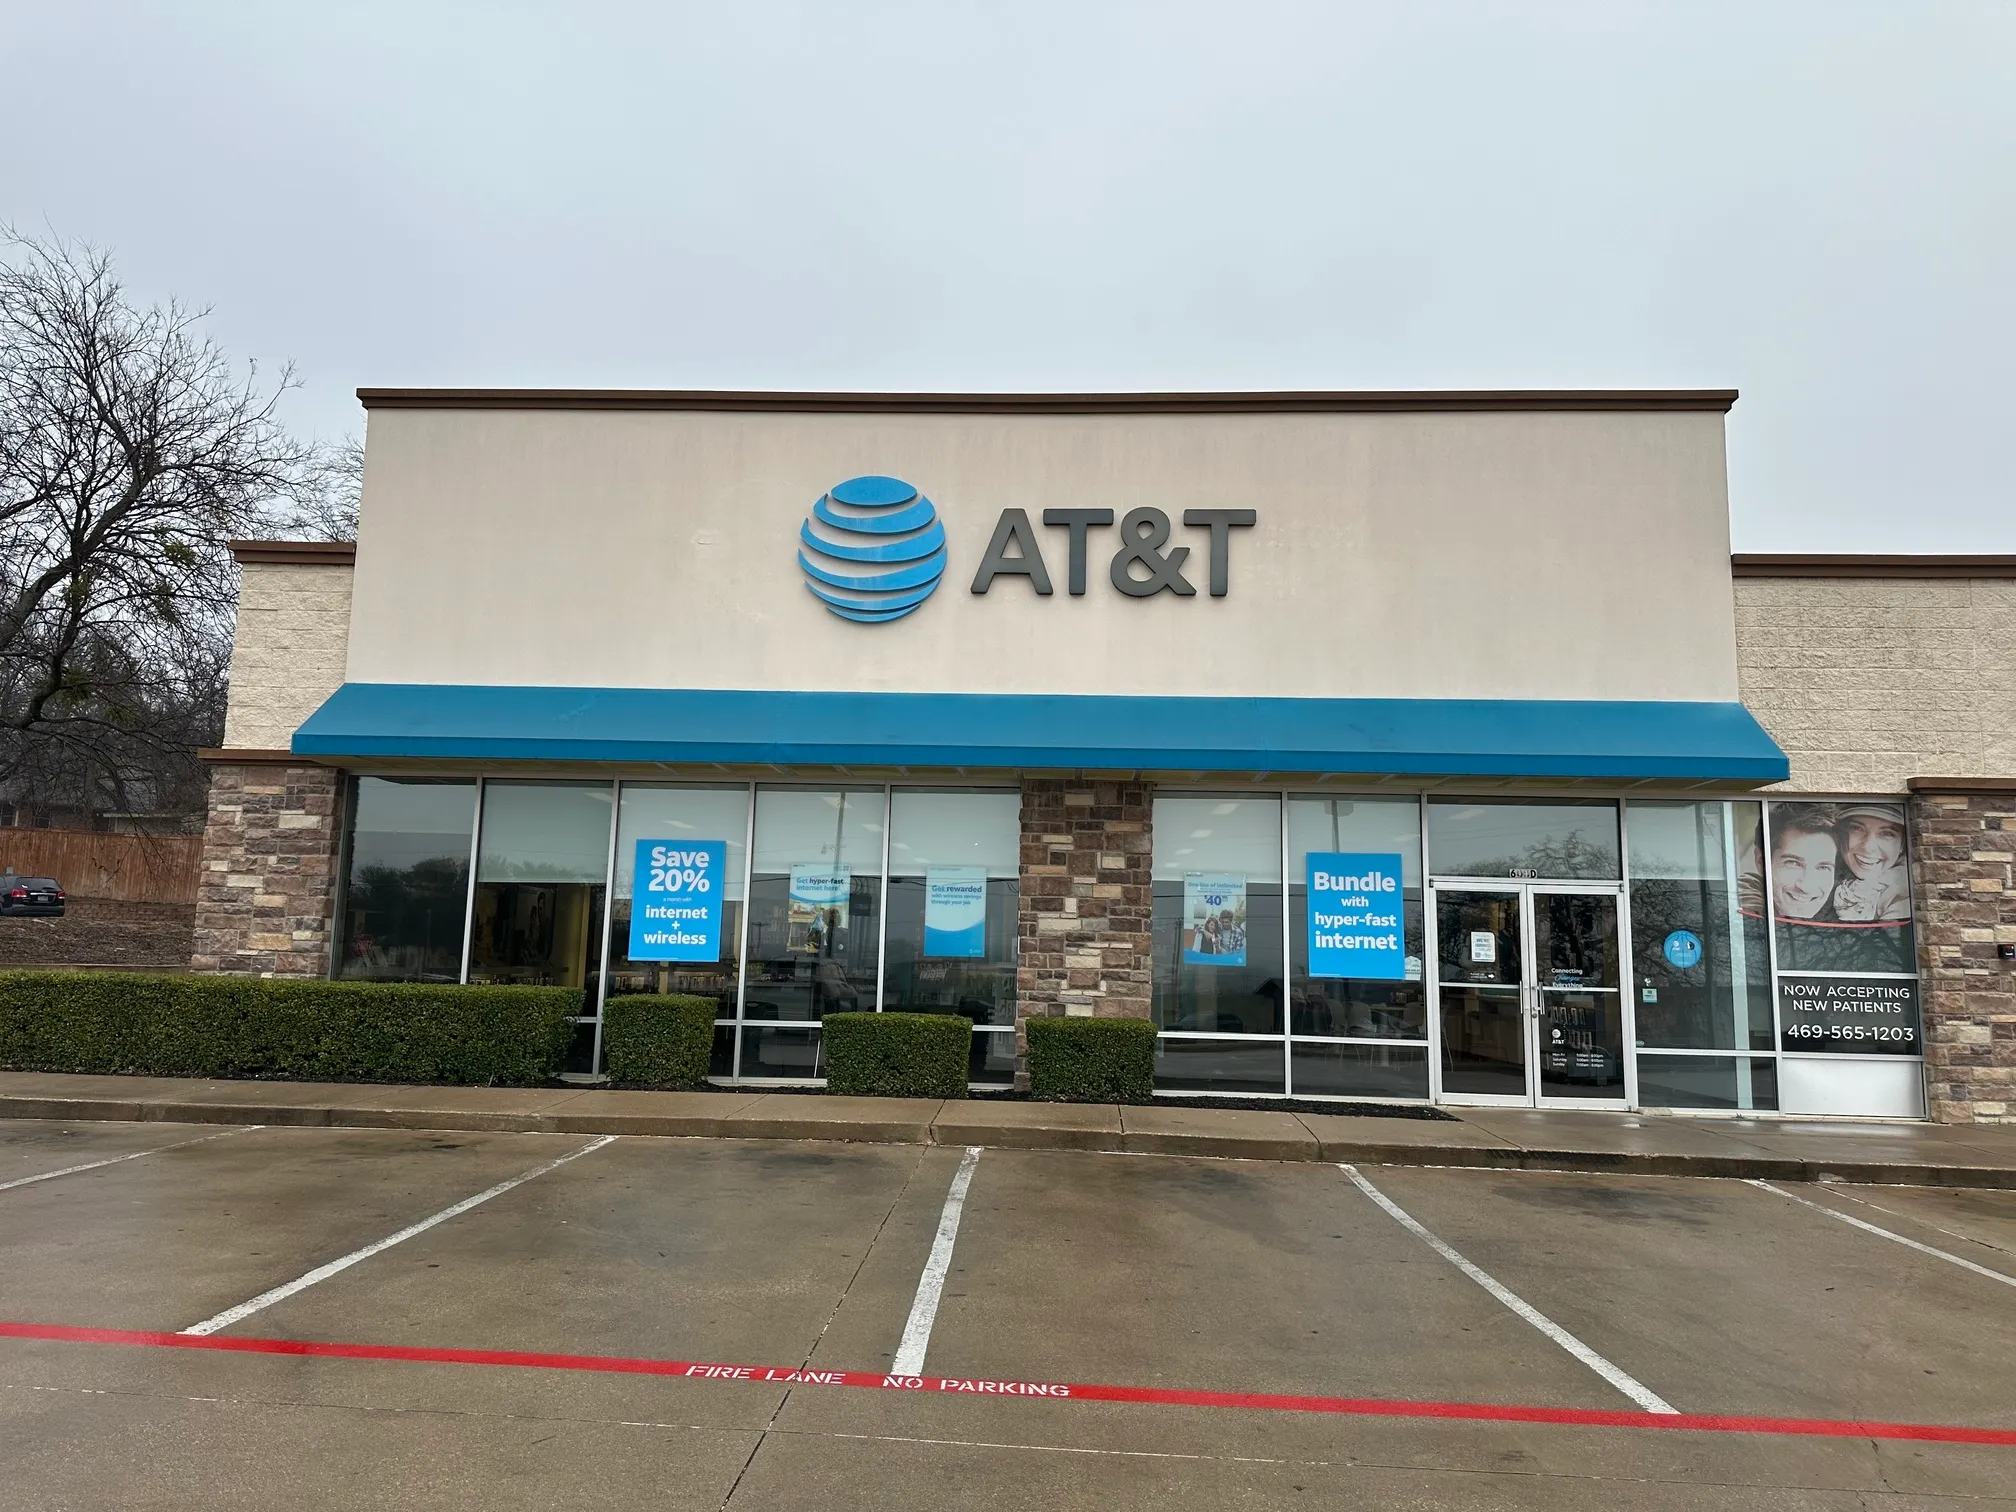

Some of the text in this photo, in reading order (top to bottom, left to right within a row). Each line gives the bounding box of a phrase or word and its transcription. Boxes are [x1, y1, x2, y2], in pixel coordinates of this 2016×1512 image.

[970, 506, 1257, 597] AT&T
[650, 846, 710, 868] Save
[648, 868, 710, 893] 20%
[809, 877, 844, 885] hyper-fast
[1314, 871, 1396, 892] Bundle
[946, 885, 982, 893] rewarded
[1341, 895, 1369, 907] with
[645, 904, 708, 919] internet
[672, 920, 680, 930] +
[1314, 911, 1397, 929] hyper-fast
[643, 930, 707, 945] wireless
[1315, 930, 1398, 950] internet
[1551, 967, 1583, 975] Connecting
[1784, 985, 1910, 999] NOW ACCEPTING
[1793, 1000, 1901, 1013] NEW PATIENTS
[1787, 1024, 1914, 1041] 469-565-1203
[685, 1365, 1070, 1397] FIRE LANE NO PARKING
